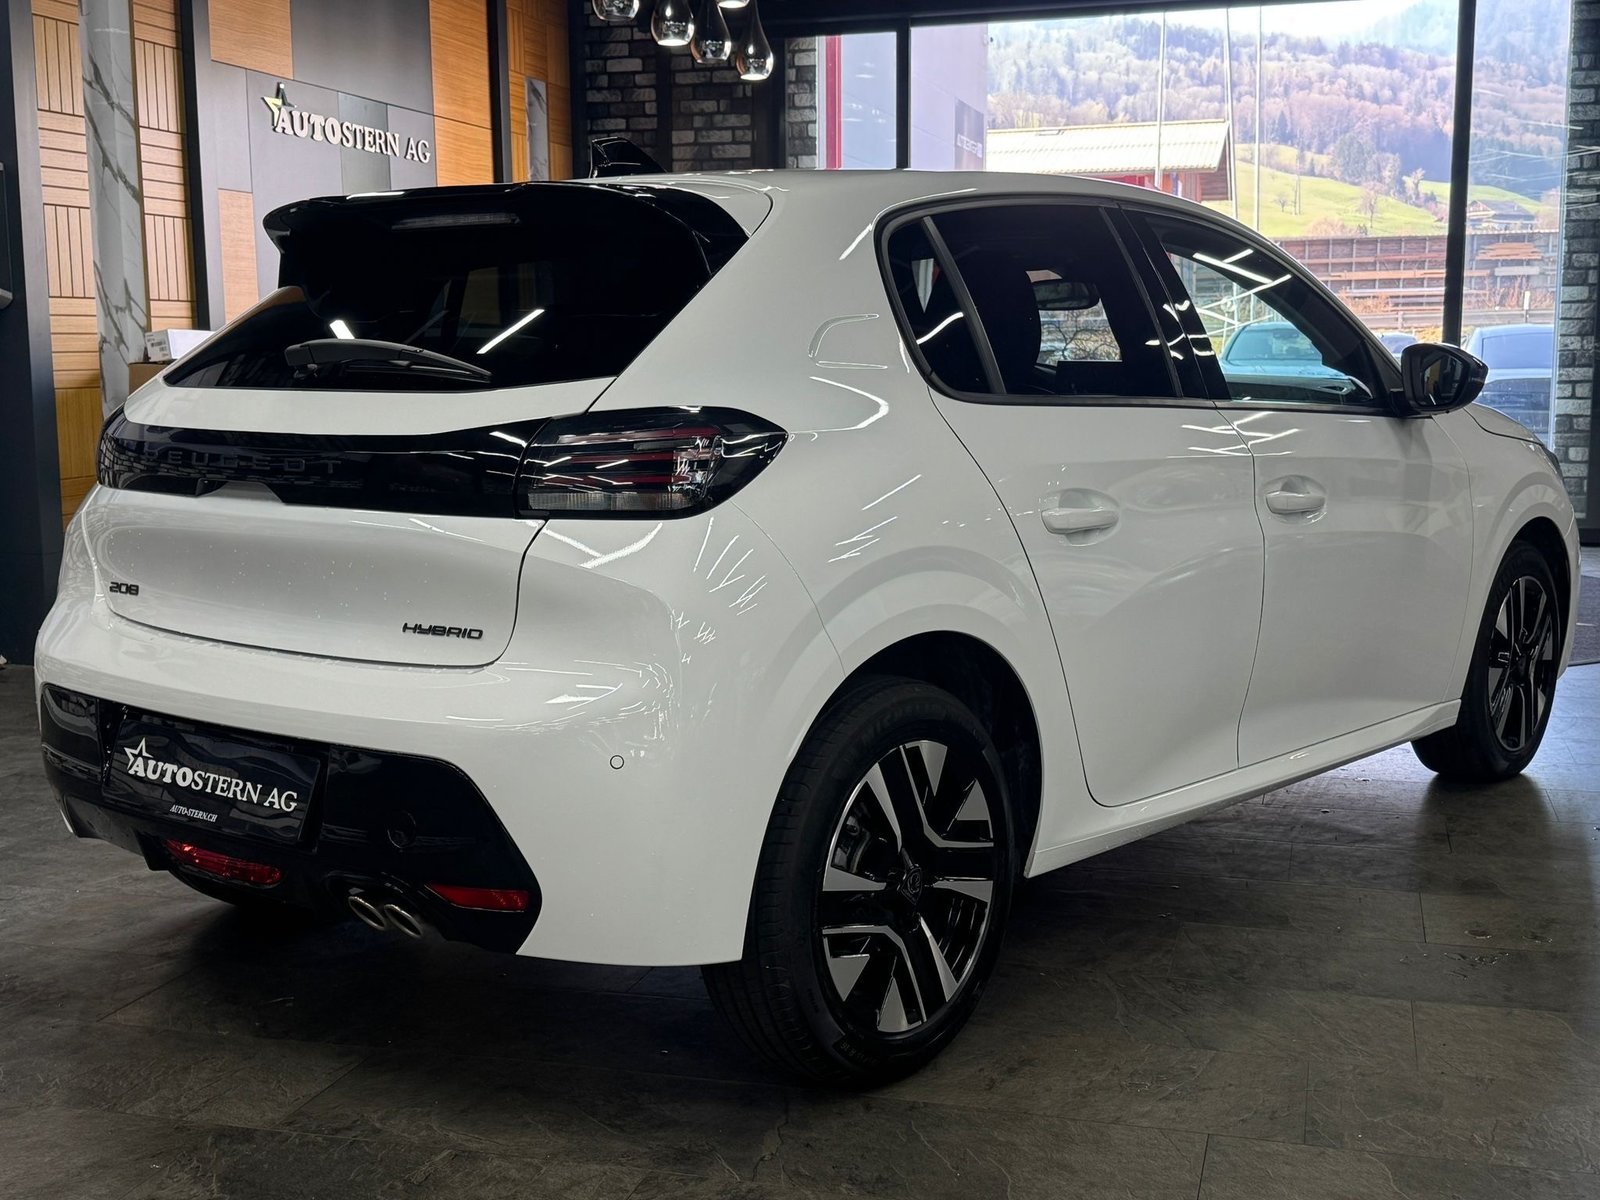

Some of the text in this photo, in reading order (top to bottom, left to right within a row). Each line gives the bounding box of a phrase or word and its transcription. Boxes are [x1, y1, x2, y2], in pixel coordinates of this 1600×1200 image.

[274, 106, 431, 163] AUTOSTERN AG
[109, 581, 140, 596] 208
[402, 622, 484, 640] HYBRID
[128, 756, 298, 812] AUTOSTERN AG
[170, 804, 218, 823] AUTO-STERN.CH
